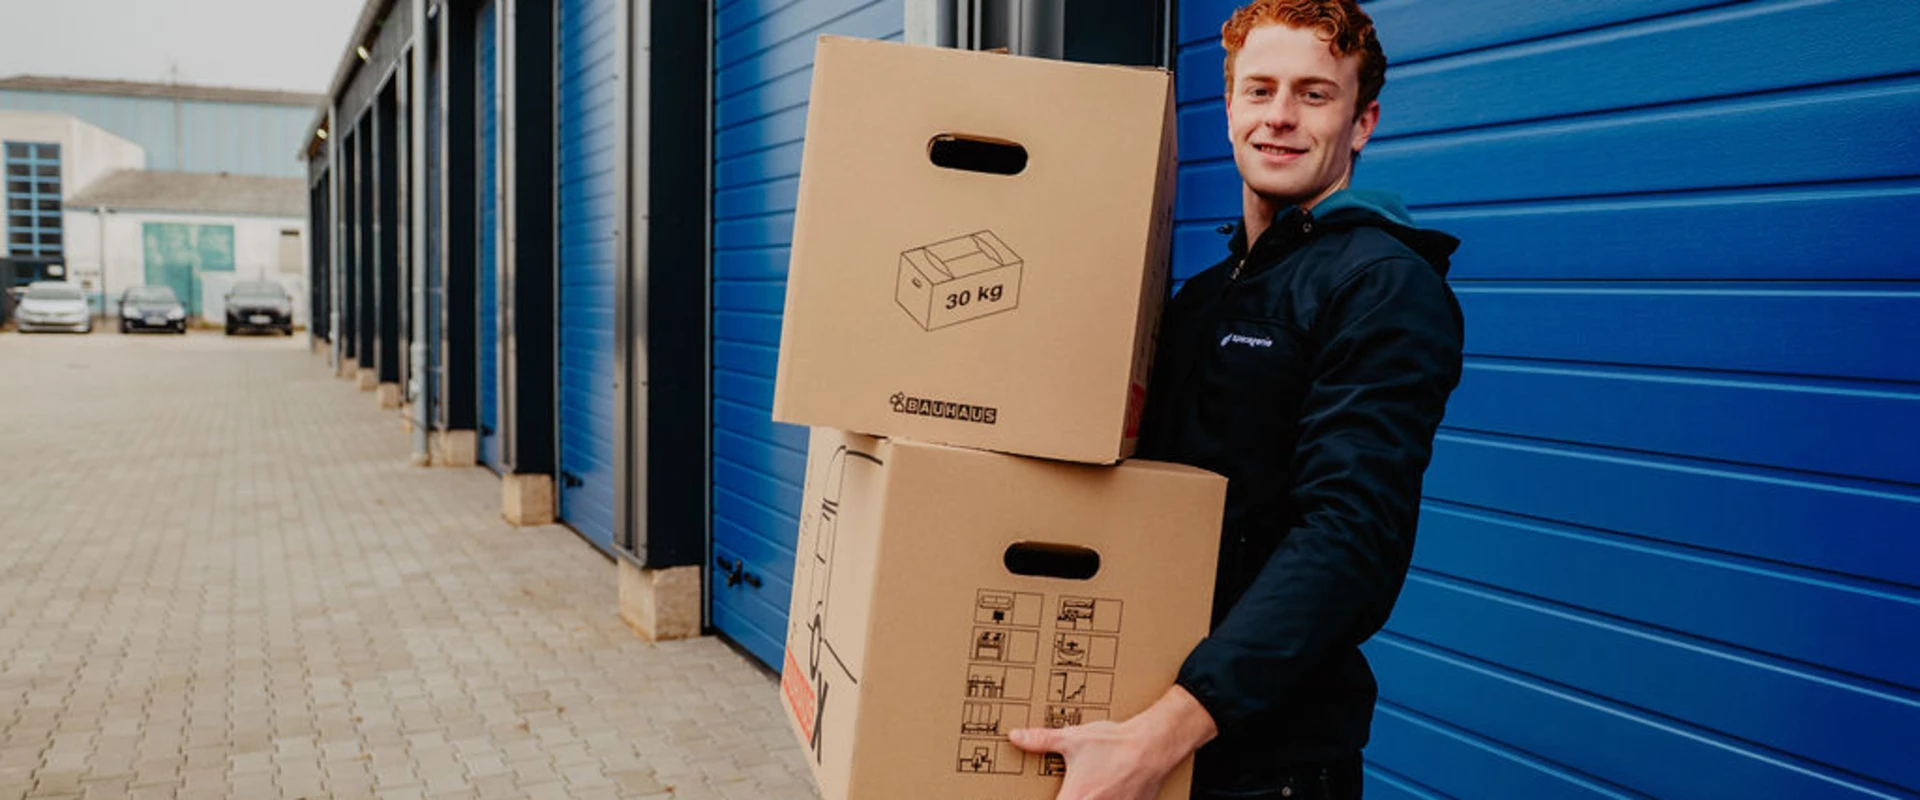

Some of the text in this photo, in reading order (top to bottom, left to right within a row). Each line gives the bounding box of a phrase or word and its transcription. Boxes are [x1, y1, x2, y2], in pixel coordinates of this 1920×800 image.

[945, 284, 1004, 310] 30 kg
[905, 397, 998, 425] BAUHAUS
